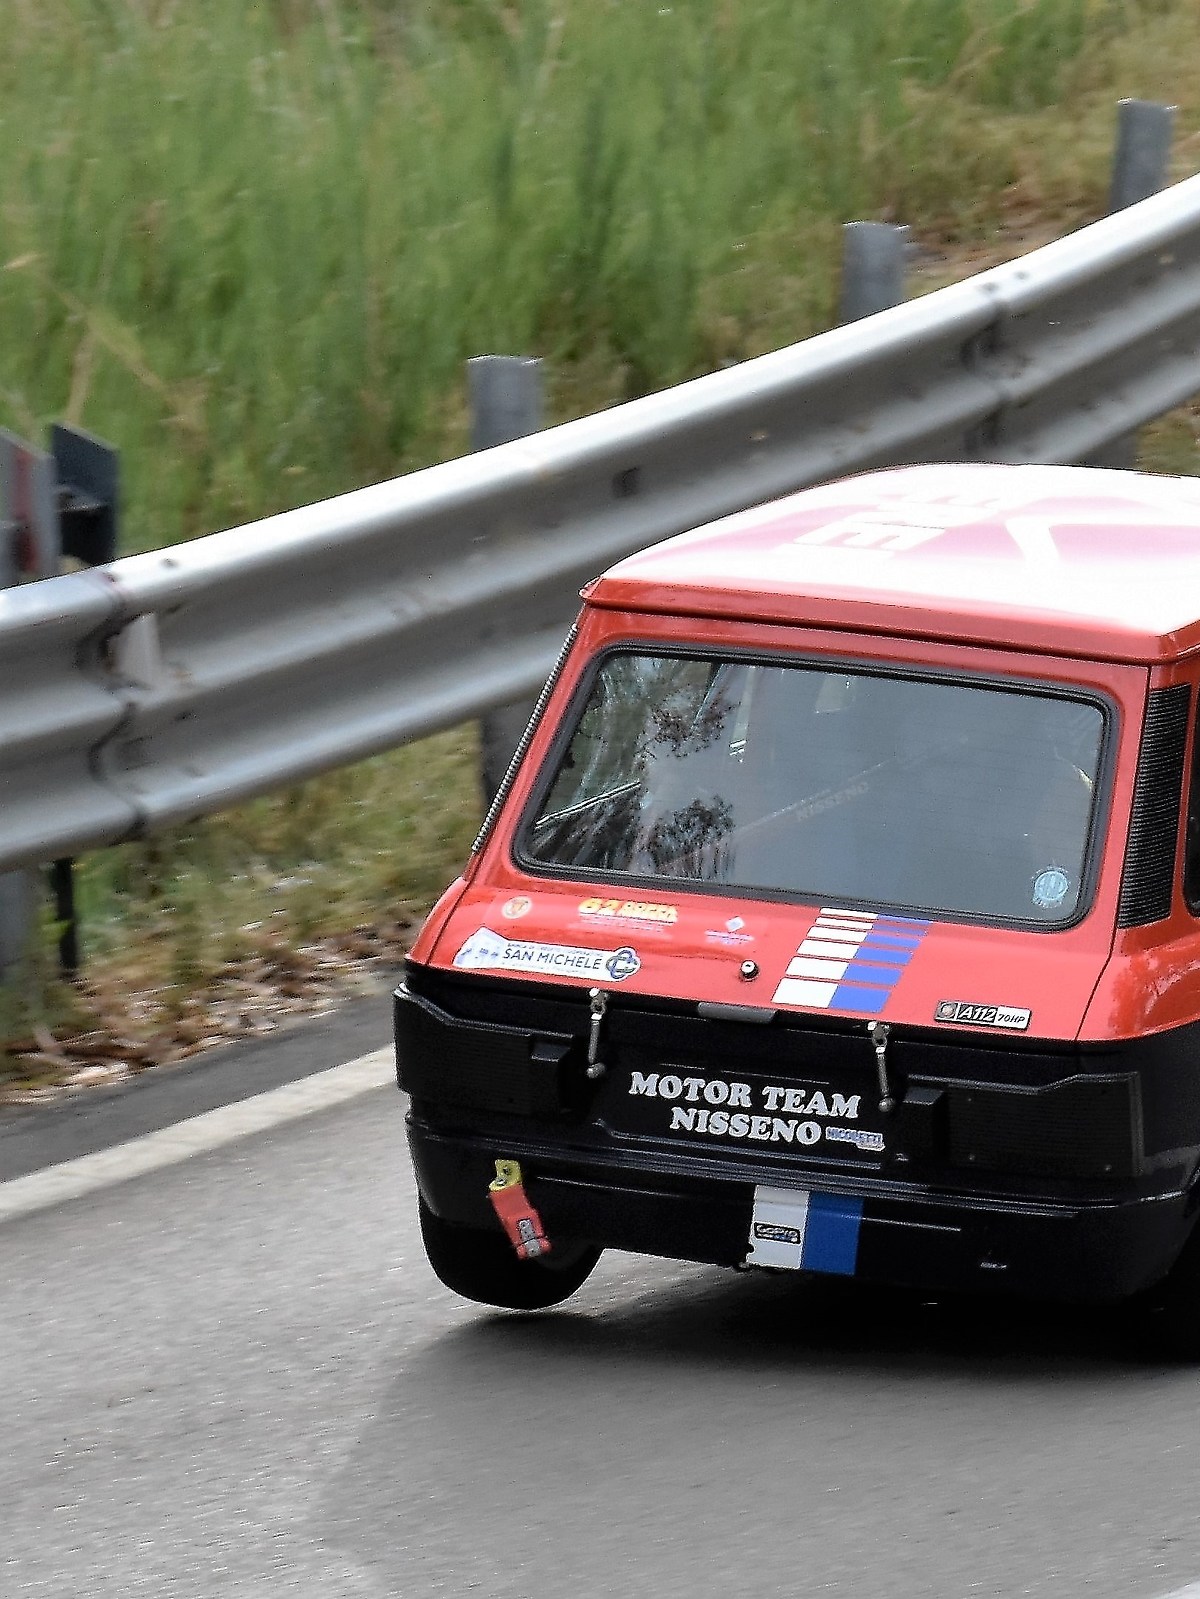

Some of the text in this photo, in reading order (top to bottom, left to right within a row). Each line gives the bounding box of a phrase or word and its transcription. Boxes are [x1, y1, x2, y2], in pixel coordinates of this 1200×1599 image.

[502, 948, 535, 961] SAN
[537, 952, 603, 970] MICHELE
[957, 1006, 998, 1022] A112
[628, 1071, 862, 1119] MOTOR TEAM
[669, 1106, 822, 1145] NISSENO
